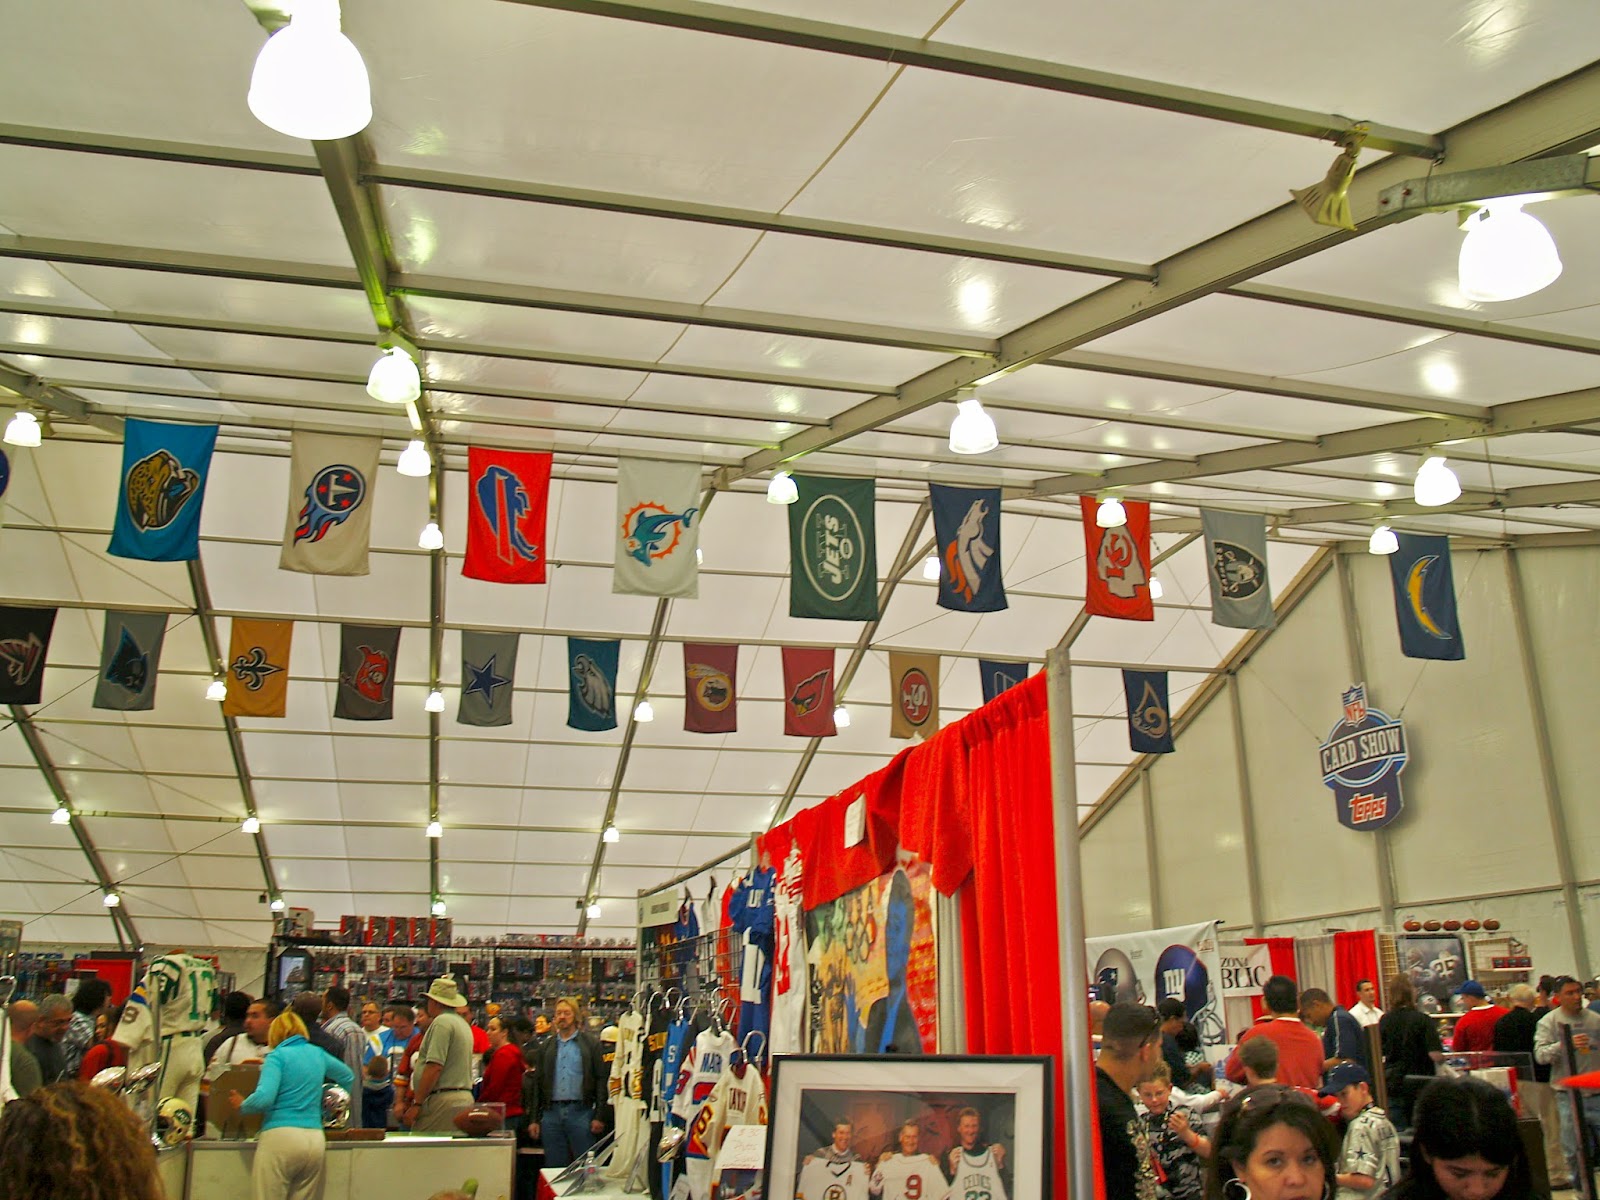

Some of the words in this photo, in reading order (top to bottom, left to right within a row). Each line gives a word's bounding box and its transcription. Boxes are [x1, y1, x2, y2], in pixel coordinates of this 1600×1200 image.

[1344, 701, 1366, 722] NFL
[1322, 740, 1358, 773] CARD
[1359, 727, 1401, 760] SHOW
[904, 1174, 923, 1200] 9
